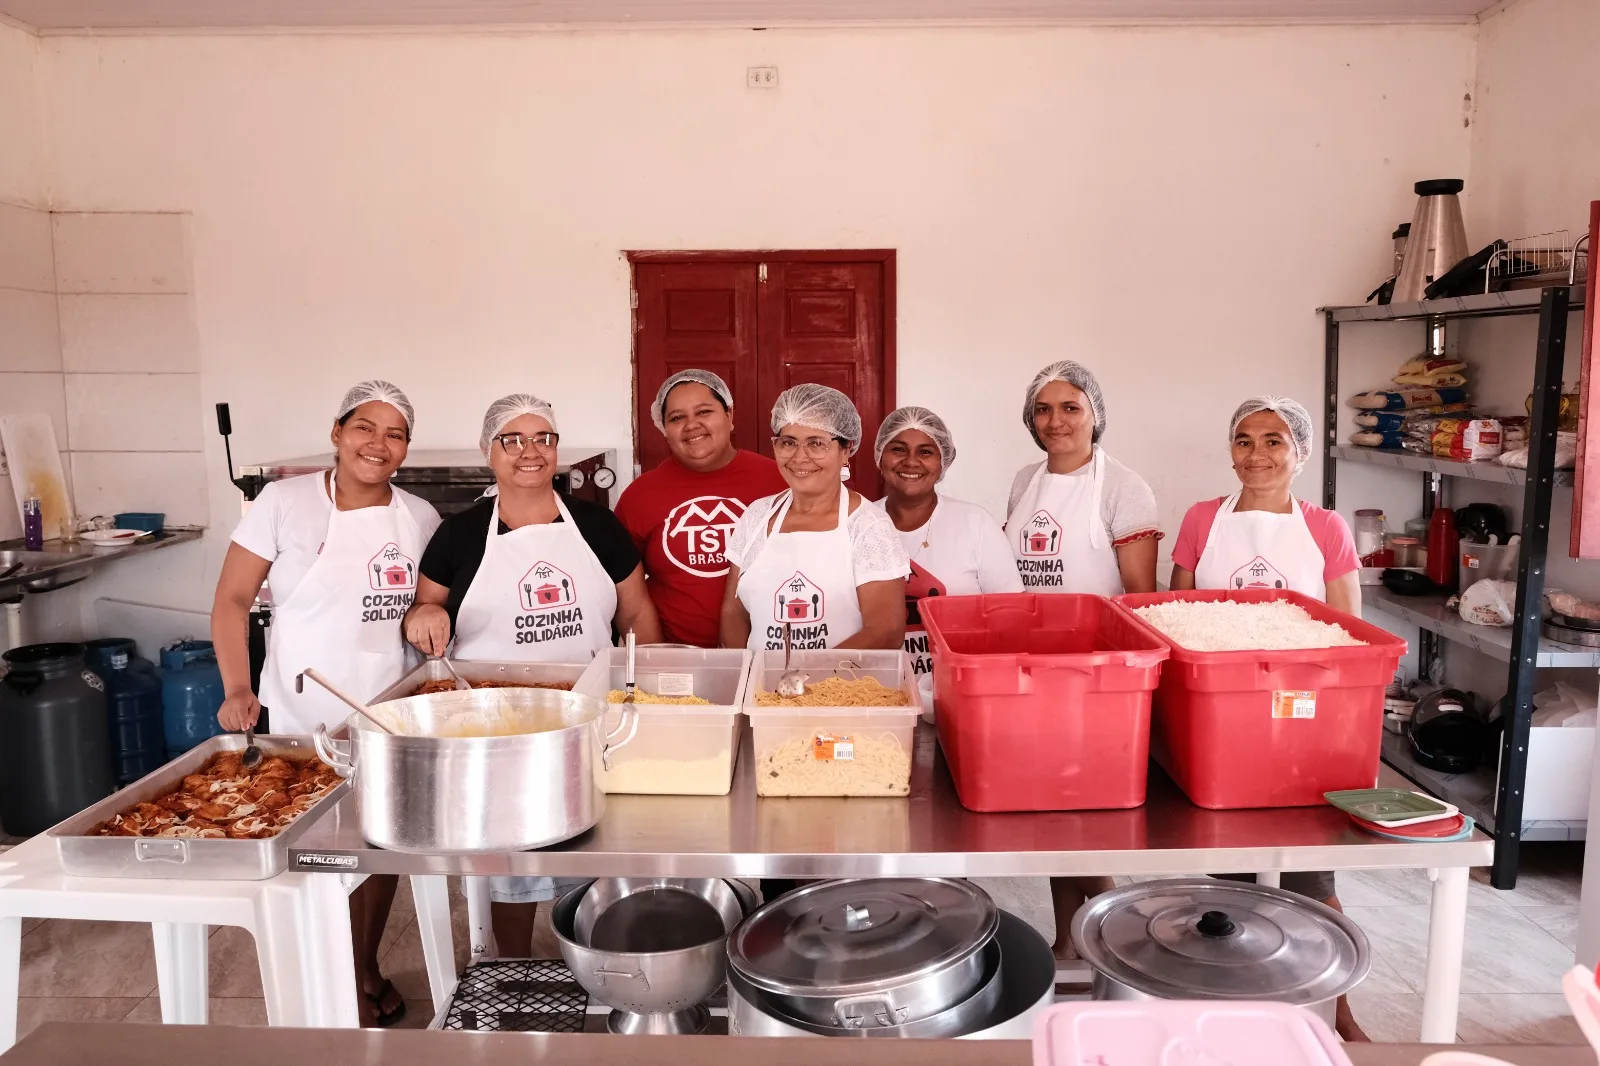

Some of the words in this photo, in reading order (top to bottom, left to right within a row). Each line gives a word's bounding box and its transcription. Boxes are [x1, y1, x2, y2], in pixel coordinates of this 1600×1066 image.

[1016, 559, 1064, 573] COZINHA
[1020, 572, 1063, 587] OLIDÁRIA
[514, 607, 583, 630] COZINHA
[515, 623, 583, 645] SOLIDÁRIA
[766, 623, 829, 641] COINHA
[298, 856, 354, 865] METALCUBAS
